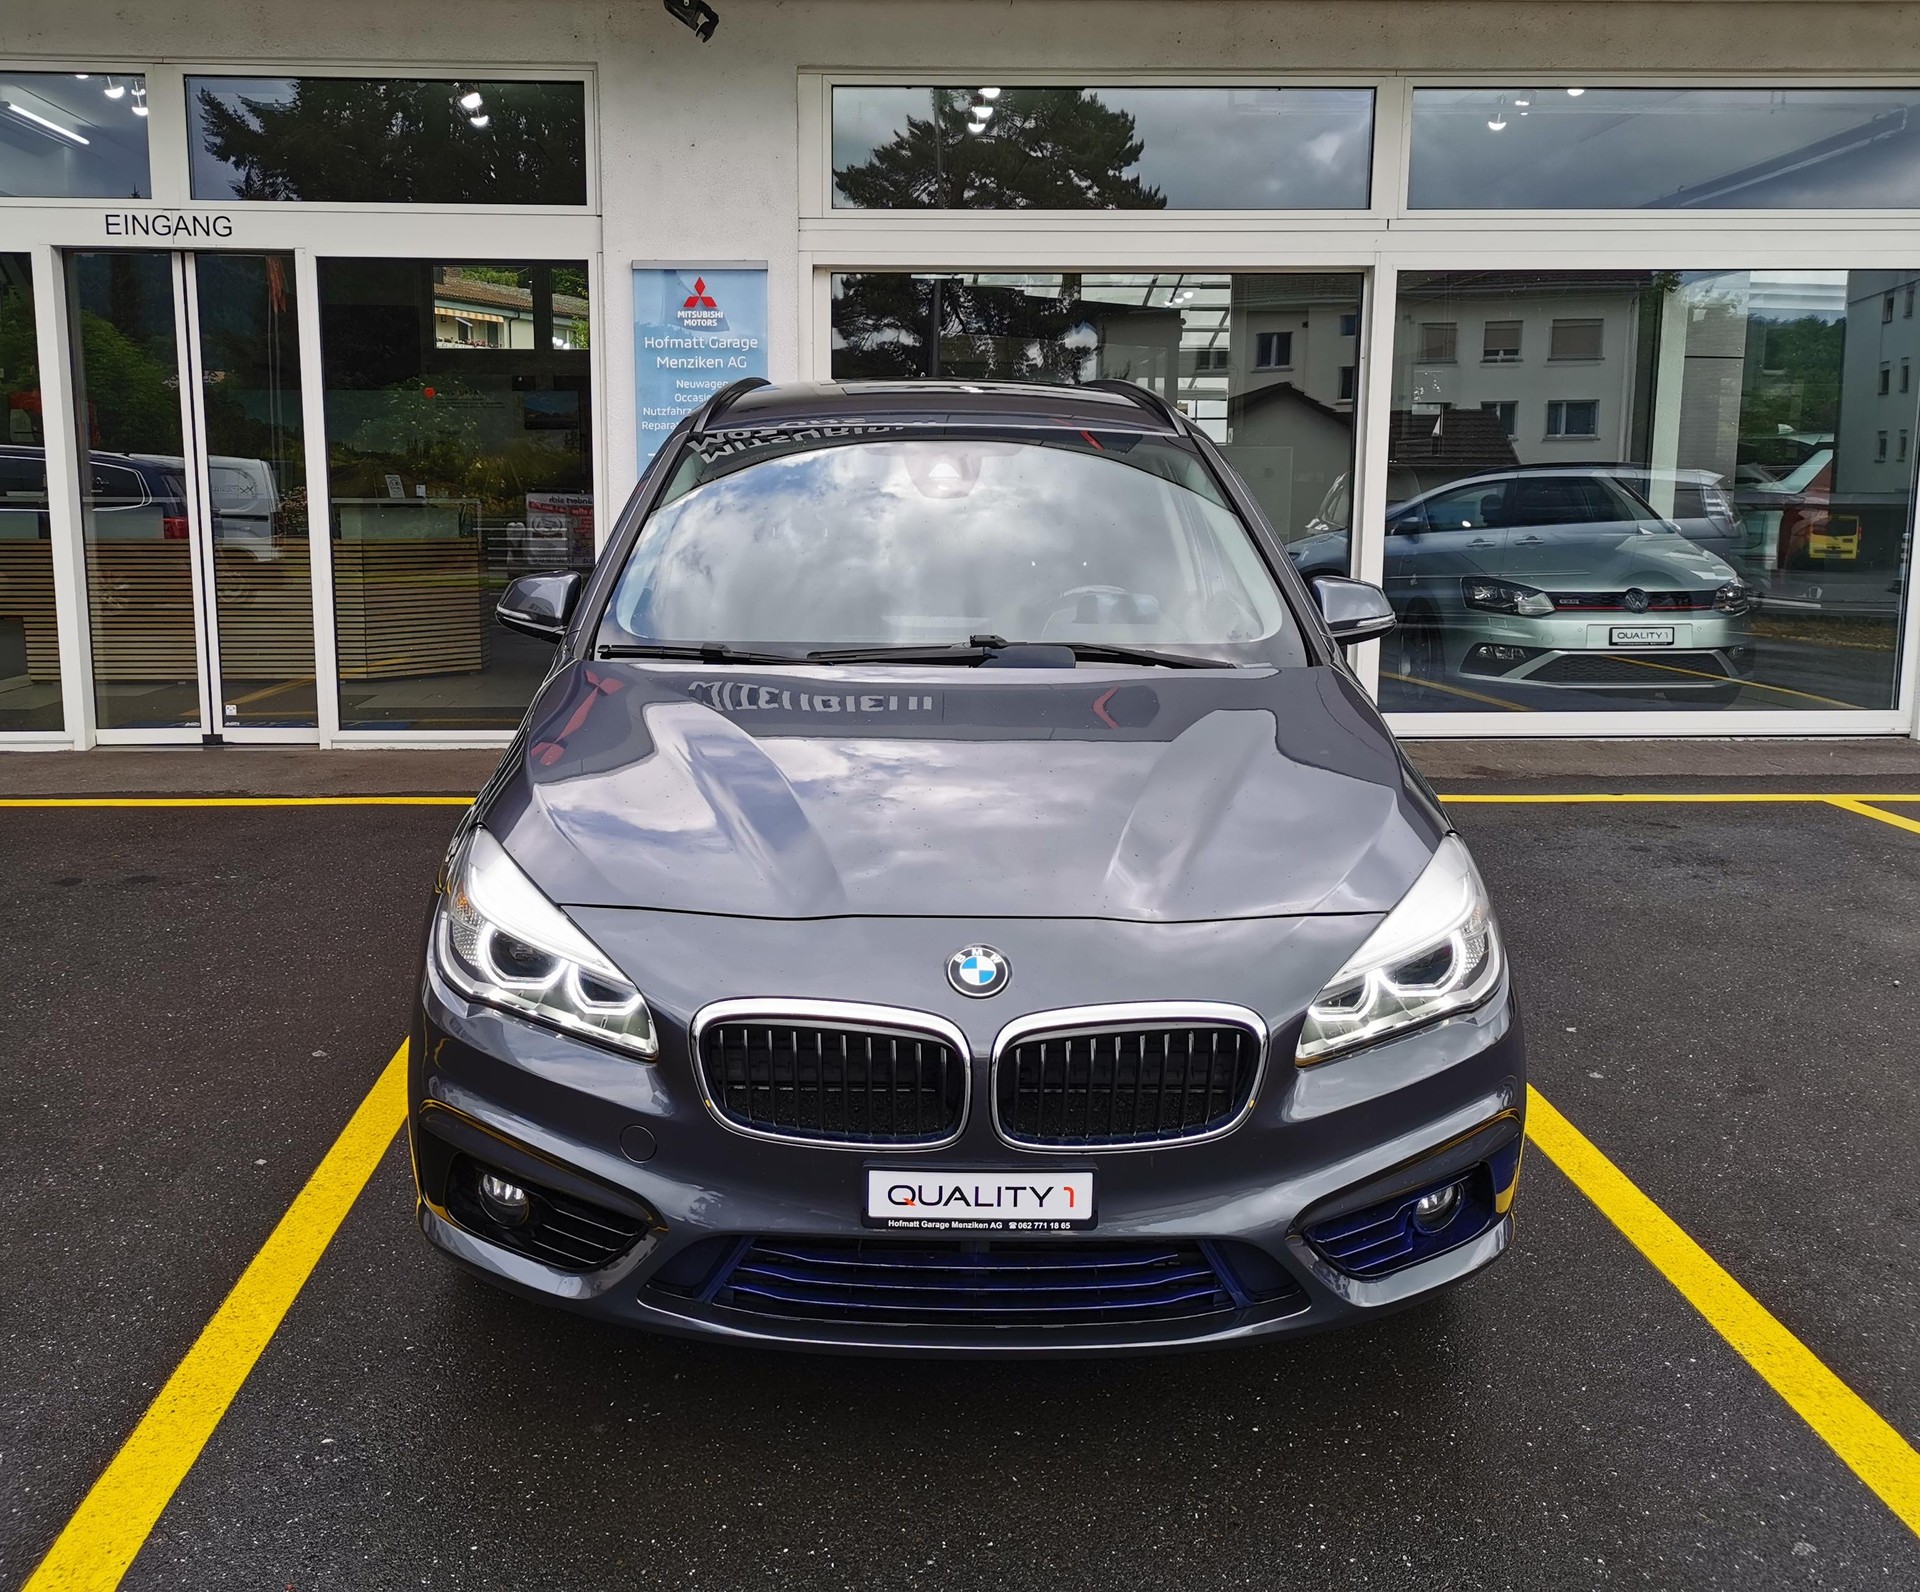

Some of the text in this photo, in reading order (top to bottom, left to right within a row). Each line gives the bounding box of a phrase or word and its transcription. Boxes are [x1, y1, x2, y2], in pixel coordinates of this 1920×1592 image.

[105, 213, 233, 238] EINGANG
[677, 310, 724, 319] MITSUBISHI
[683, 319, 718, 327] MOTORS
[644, 335, 758, 351] Hofmatt Garage
[656, 355, 747, 369] Menziken AG
[1616, 631, 1663, 640] QUALITY
[953, 947, 1003, 964] BMW
[887, 1184, 1075, 1208] QUALITY 1
[888, 1219, 920, 1228] Hofmatt
[921, 1220, 950, 1230] Garage
[951, 1220, 989, 1229] Menziken
[990, 1221, 1003, 1230] AG
[1034, 1221, 1048, 1230] 771
[1049, 1221, 1060, 1230] 18
[1060, 1221, 1071, 1230] 65
